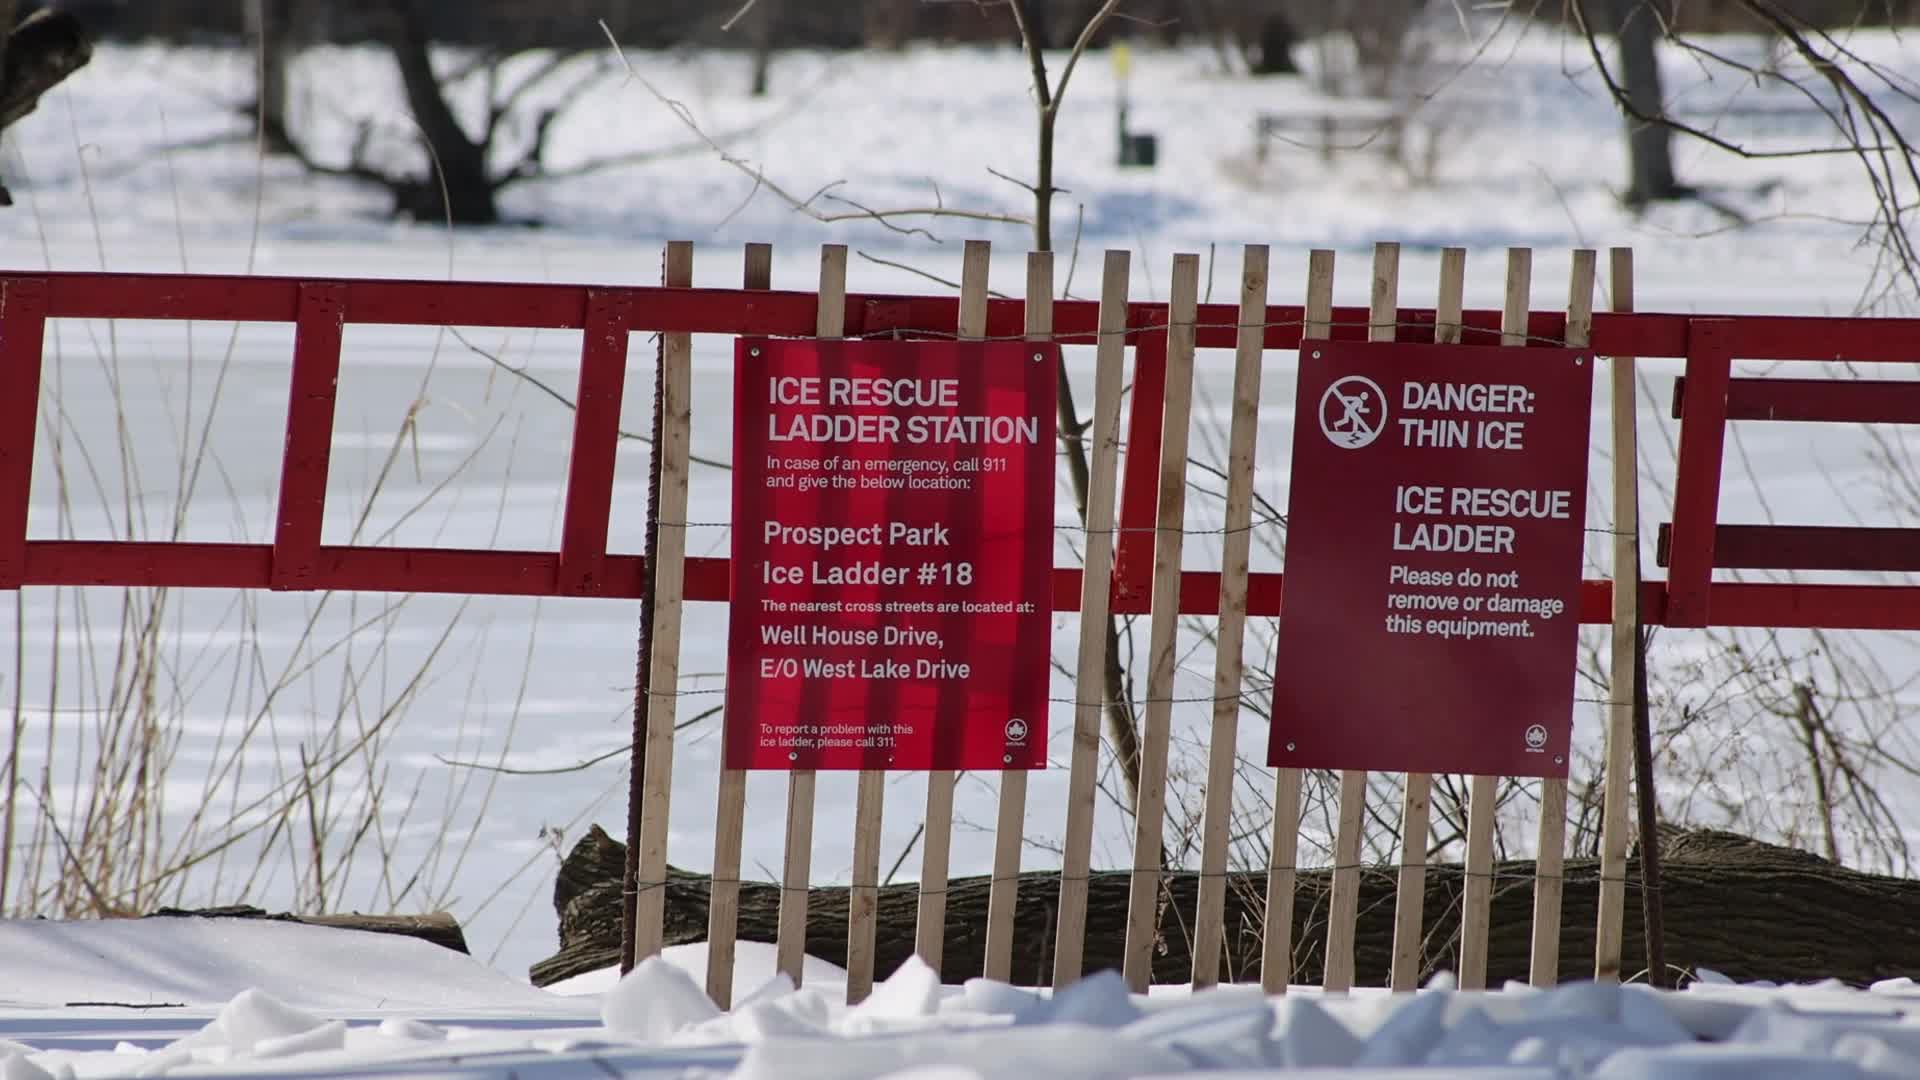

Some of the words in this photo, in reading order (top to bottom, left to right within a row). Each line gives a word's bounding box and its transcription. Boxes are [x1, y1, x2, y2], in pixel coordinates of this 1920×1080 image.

[770, 377, 820, 404] ICE
[829, 378, 958, 406] RESCUE
[1403, 382, 1535, 413] DANGER:
[769, 414, 900, 442] LADDER
[907, 416, 1037, 443] STATION
[1398, 419, 1469, 448] THIN
[1477, 421, 1524, 449] ICE
[768, 456, 780, 468] In
[784, 459, 819, 470] case
[824, 456, 839, 470] of
[842, 460, 860, 470] an
[865, 460, 949, 475] emergency,
[953, 458, 979, 471] call
[983, 458, 1005, 471] 911
[767, 474, 794, 487] and
[799, 474, 828, 491] give
[832, 475, 856, 488] the
[861, 475, 904, 488] below
[909, 475, 970, 489] location:
[1396, 486, 1444, 514] ICE
[1451, 488, 1570, 518] RESCUE
[765, 521, 882, 550] Prospect
[890, 522, 949, 545] Park
[1393, 523, 1515, 553] LADDER
[764, 561, 803, 584] Ice
[813, 561, 910, 585] Ladder
[917, 563, 972, 585] #18
[1390, 566, 1453, 586] Please
[1458, 568, 1481, 587] do
[1486, 571, 1518, 588] not
[761, 600, 786, 611] The
[790, 601, 842, 612] nearest
[845, 603, 882, 612] cross
[885, 601, 934, 612] streets
[937, 603, 959, 612] are
[962, 601, 1012, 612] located
[1016, 602, 1034, 612] at:
[1388, 594, 1459, 610] remove
[1463, 597, 1484, 611] or
[1487, 593, 1563, 619] damage
[761, 625, 806, 644] Well
[813, 626, 878, 645] House
[884, 626, 943, 649] Drive,
[1385, 614, 1421, 633] this
[1426, 616, 1534, 640] equipment.
[761, 658, 797, 678] E/O
[803, 659, 855, 678] West
[861, 659, 910, 678] Lake
[917, 659, 970, 678] Drive
[760, 723, 773, 734] To
[775, 725, 808, 737] report
[811, 726, 817, 734] a
[820, 724, 864, 736] problem
[868, 724, 890, 734] with
[893, 724, 913, 734] this
[760, 736, 776, 746] ice
[779, 736, 814, 748] ladder,
[817, 736, 853, 749] please
[855, 736, 874, 747] call
[877, 737, 896, 747] 311.
